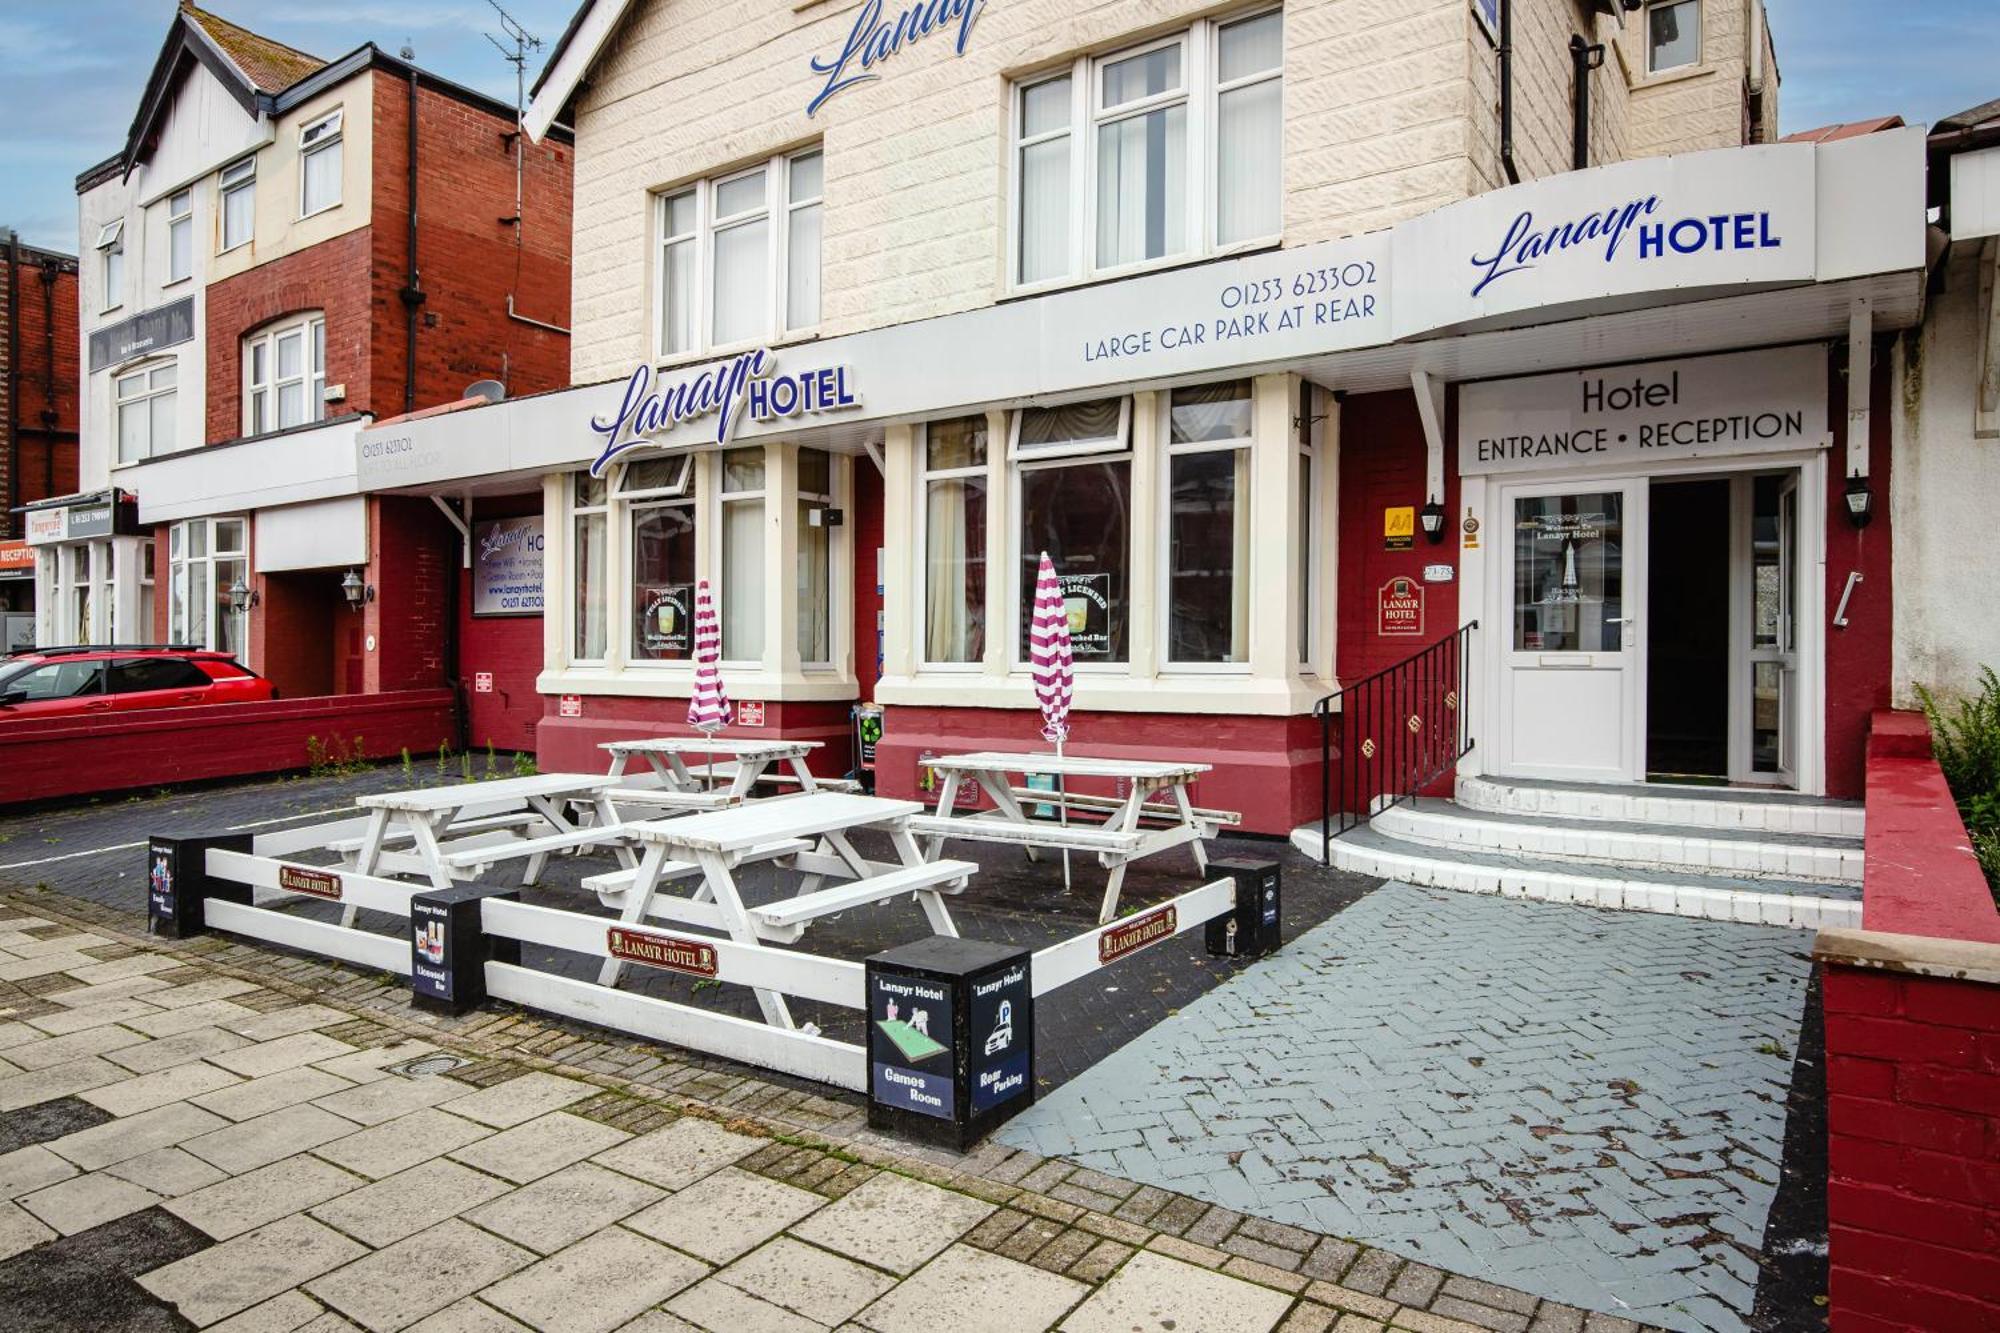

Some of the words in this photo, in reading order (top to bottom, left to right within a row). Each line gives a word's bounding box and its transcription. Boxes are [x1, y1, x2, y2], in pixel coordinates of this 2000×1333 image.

[807, 0, 984, 118] Lanay
[1471, 194, 1661, 297] Lanayr
[1639, 211, 1781, 259] HOTEL
[1221, 277, 1282, 308] 01253
[1292, 261, 1377, 297] 623302
[1085, 331, 1152, 362] LARGE
[1160, 323, 1205, 349] CAR
[1215, 311, 1268, 341] PARK
[1278, 306, 1304, 331] AT
[1315, 294, 1376, 325] REAR
[1582, 370, 1679, 414] Hotel
[590, 348, 767, 478] Lanayr
[750, 365, 855, 419] HOTEL
[1477, 428, 1608, 462] ENTRANCE
[1639, 410, 1803, 449] RECEPTION
[1572, 530, 1600, 539] Hotel
[1383, 600, 1419, 609] LANAYR
[1386, 610, 1417, 619] HOTEL
[1143, 919, 1165, 940] HOTEL
[624, 940, 662, 960] LANAYR
[663, 947, 698, 968] HOTEL
[879, 980, 913, 997] Lanayr
[915, 986, 944, 1001] Hotel
[976, 980, 1003, 997] Lanayr
[1003, 970, 1024, 987] Hotel
[884, 1068, 926, 1089] Games
[980, 1069, 1002, 1088] Rear
[993, 1073, 1023, 1095] Parking
[910, 1088, 943, 1107] Room
